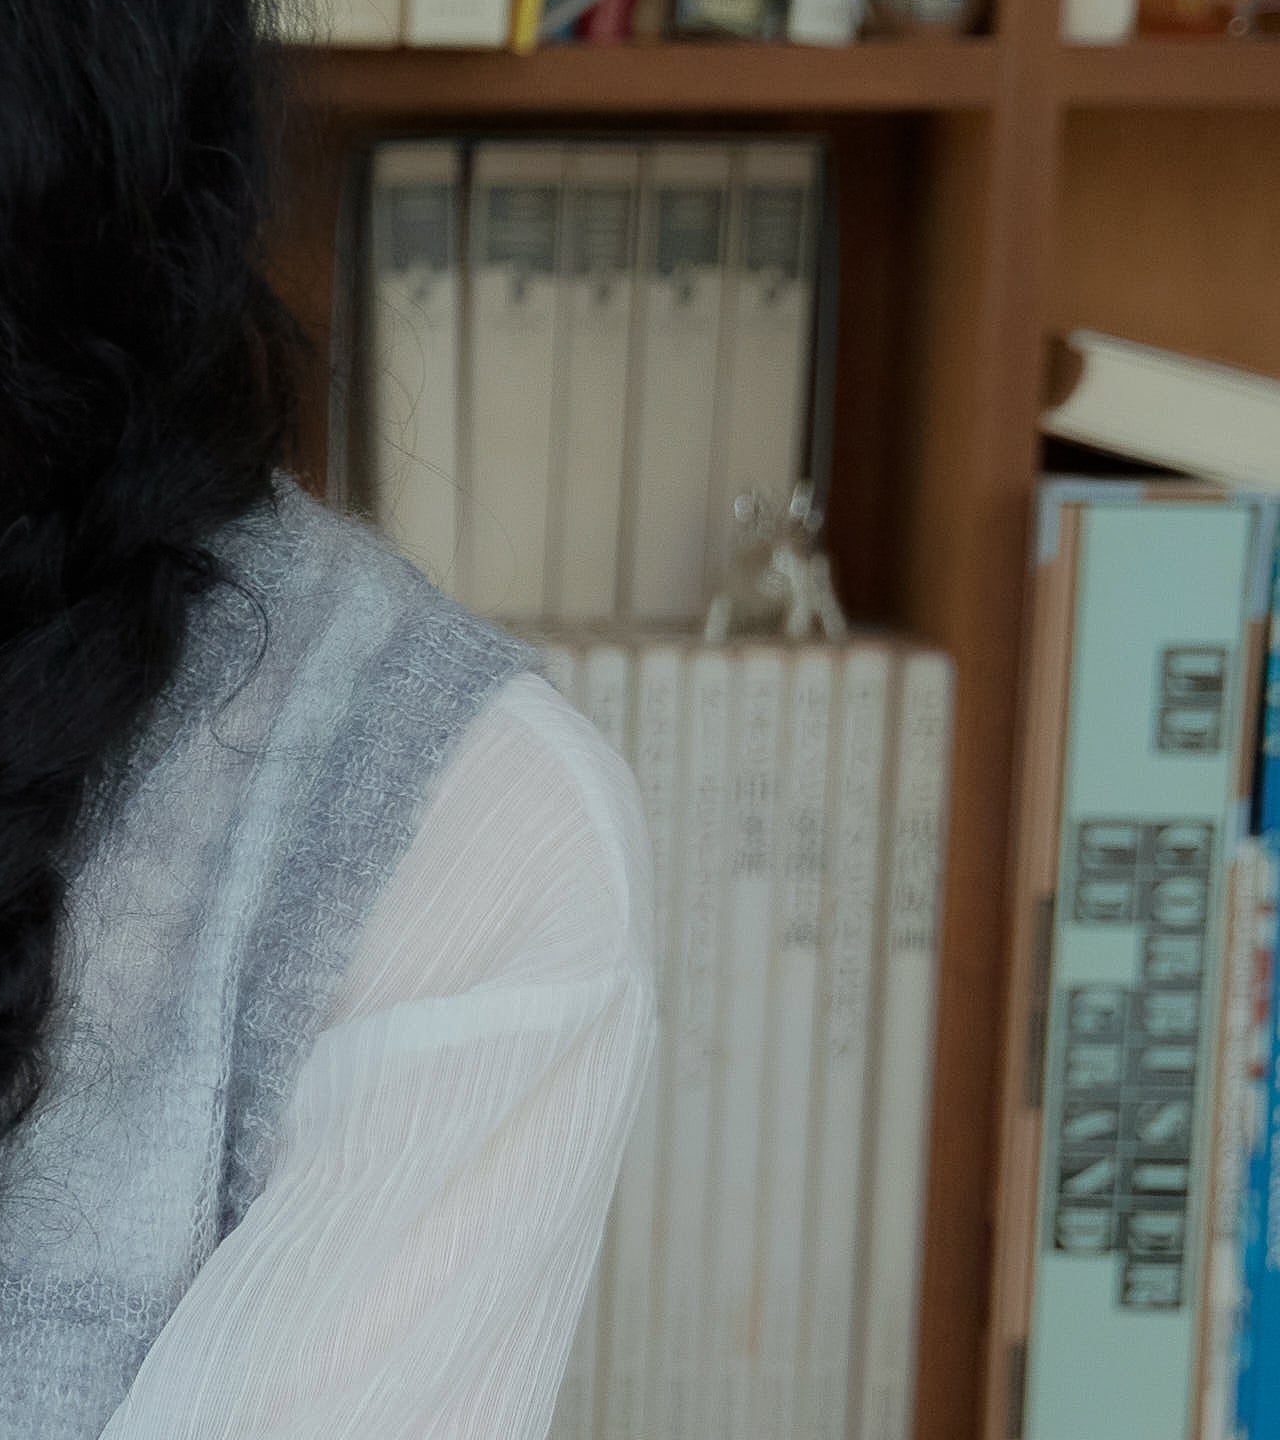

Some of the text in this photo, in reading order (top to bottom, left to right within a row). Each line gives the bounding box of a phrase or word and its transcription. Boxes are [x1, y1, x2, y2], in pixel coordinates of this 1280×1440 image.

[1054, 822, 1140, 1253] LE GRAND
[1119, 647, 1228, 1311] LE CORBUSIER
